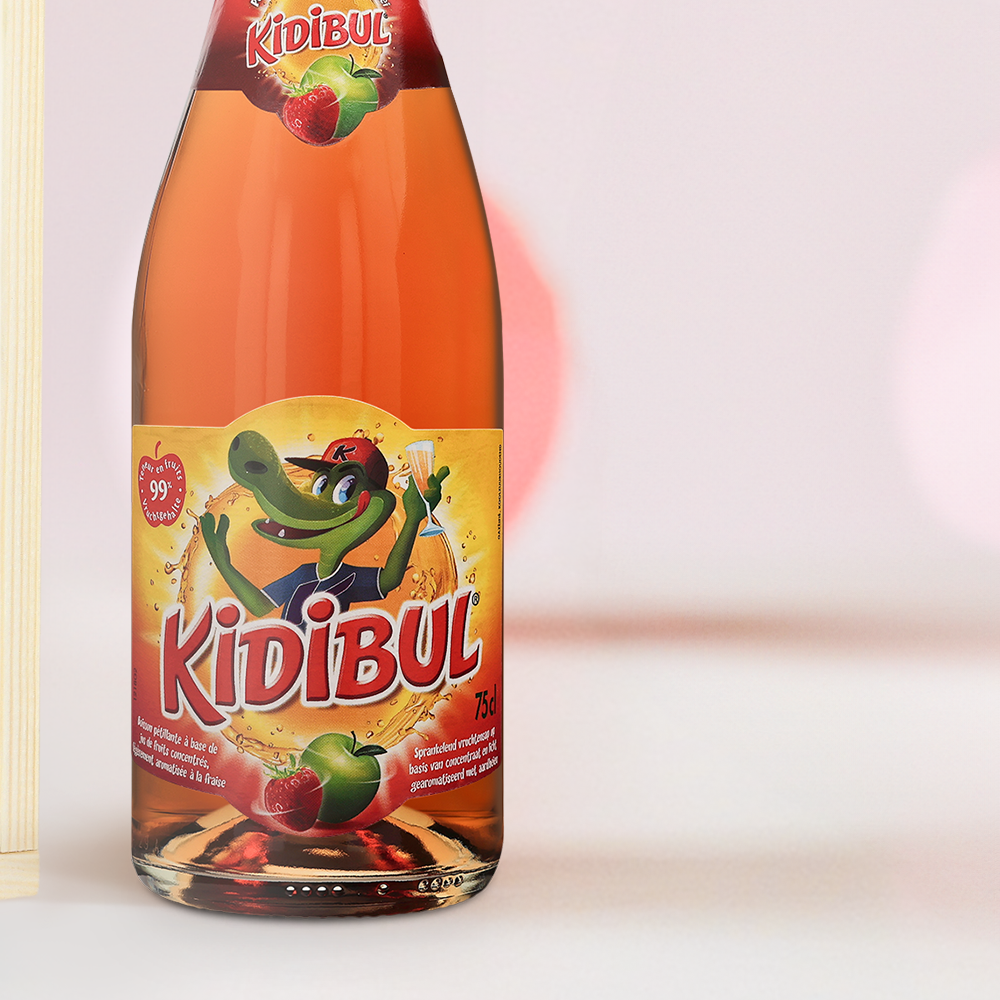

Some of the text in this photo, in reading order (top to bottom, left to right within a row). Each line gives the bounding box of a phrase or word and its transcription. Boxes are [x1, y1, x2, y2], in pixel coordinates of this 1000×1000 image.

[331, 444, 357, 462] K
[156, 465, 164, 474] en
[146, 737, 153, 748] de
[153, 740, 169, 756] fruits
[153, 725, 182, 745] pétillante
[183, 735, 189, 747] à
[190, 737, 207, 752] base
[208, 742, 218, 755] de
[414, 739, 457, 760] Sprankelend
[409, 762, 428, 775] basis
[430, 760, 443, 771] van
[189, 769, 195, 781] à
[195, 770, 202, 783] la
[204, 773, 227, 788] fraise
[410, 768, 465, 793] gearomatiseerd
